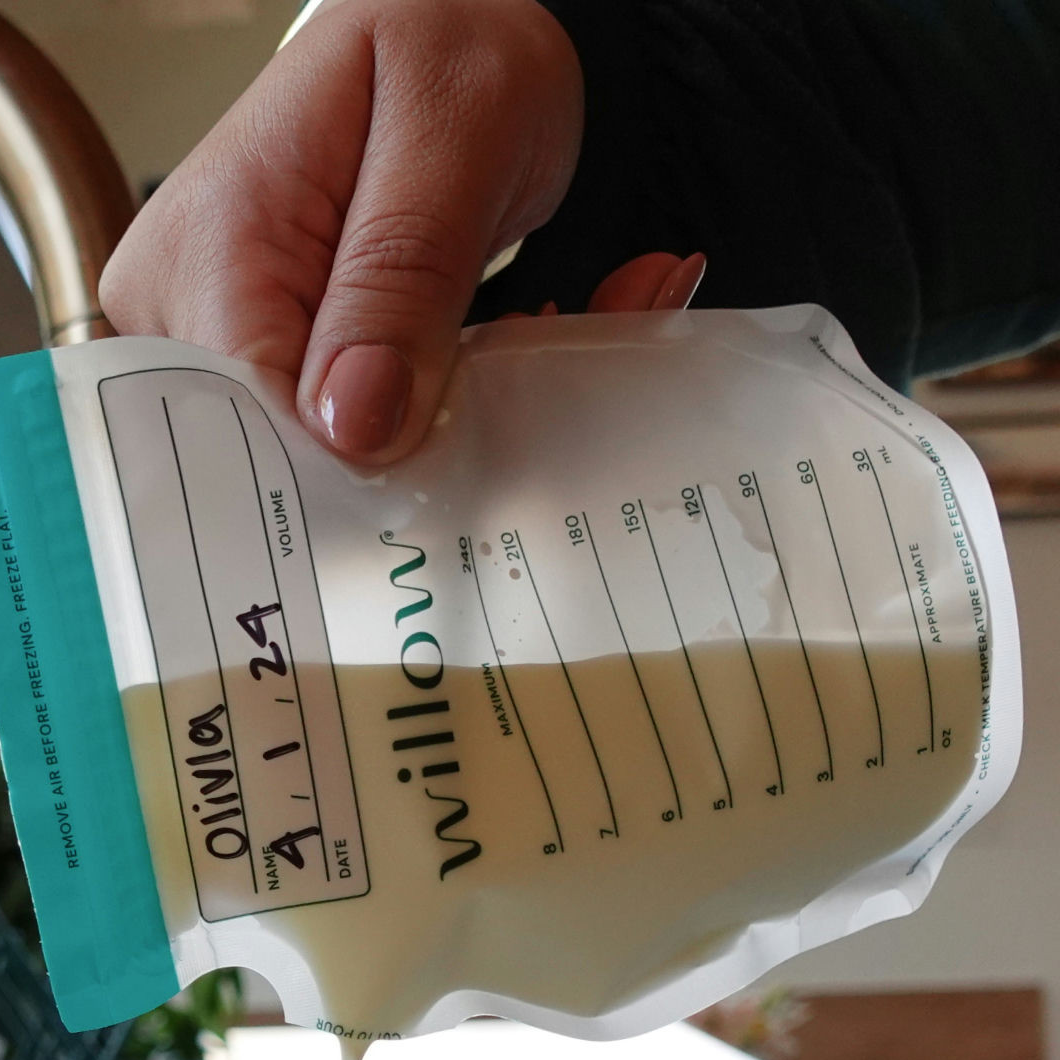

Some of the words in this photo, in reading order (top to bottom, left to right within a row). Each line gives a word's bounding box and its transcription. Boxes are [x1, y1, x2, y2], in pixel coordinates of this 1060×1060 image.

[797, 461, 814, 484] 60
[852, 451, 870, 472] 30
[681, 487, 701, 517] 120
[738, 474, 755, 498] 90
[936, 466, 961, 527] FEEDING
[270, 490, 293, 557] VOLUME
[565, 515, 585, 547] 180
[621, 502, 641, 534] 150
[459, 536, 472, 573] 240
[501, 532, 520, 562] 210
[953, 529, 976, 585] BEFORE
[4, 555, 27, 612] FREEZE
[909, 542, 942, 643] APPROXIMATE
[968, 589, 990, 690] TEMPERATURE
[18, 616, 45, 699] FREEZING.
[481, 662, 513, 736] MAXIMUM
[982, 694, 991, 730] MILK
[35, 703, 59, 766] BEFORE
[866, 757, 878, 768] 2
[917, 747, 928, 755] 1
[979, 733, 991, 780] CHECK
[49, 769, 64, 796] AIR
[766, 784, 778, 796] 4
[817, 771, 829, 782] 3
[662, 809, 675, 822] 6
[713, 799, 726, 810] 5
[55, 800, 80, 869] REMOVE
[543, 843, 557, 855] 8
[599, 828, 613, 839] 7
[262, 845, 280, 890] NAME
[334, 838, 351, 879] DATE
